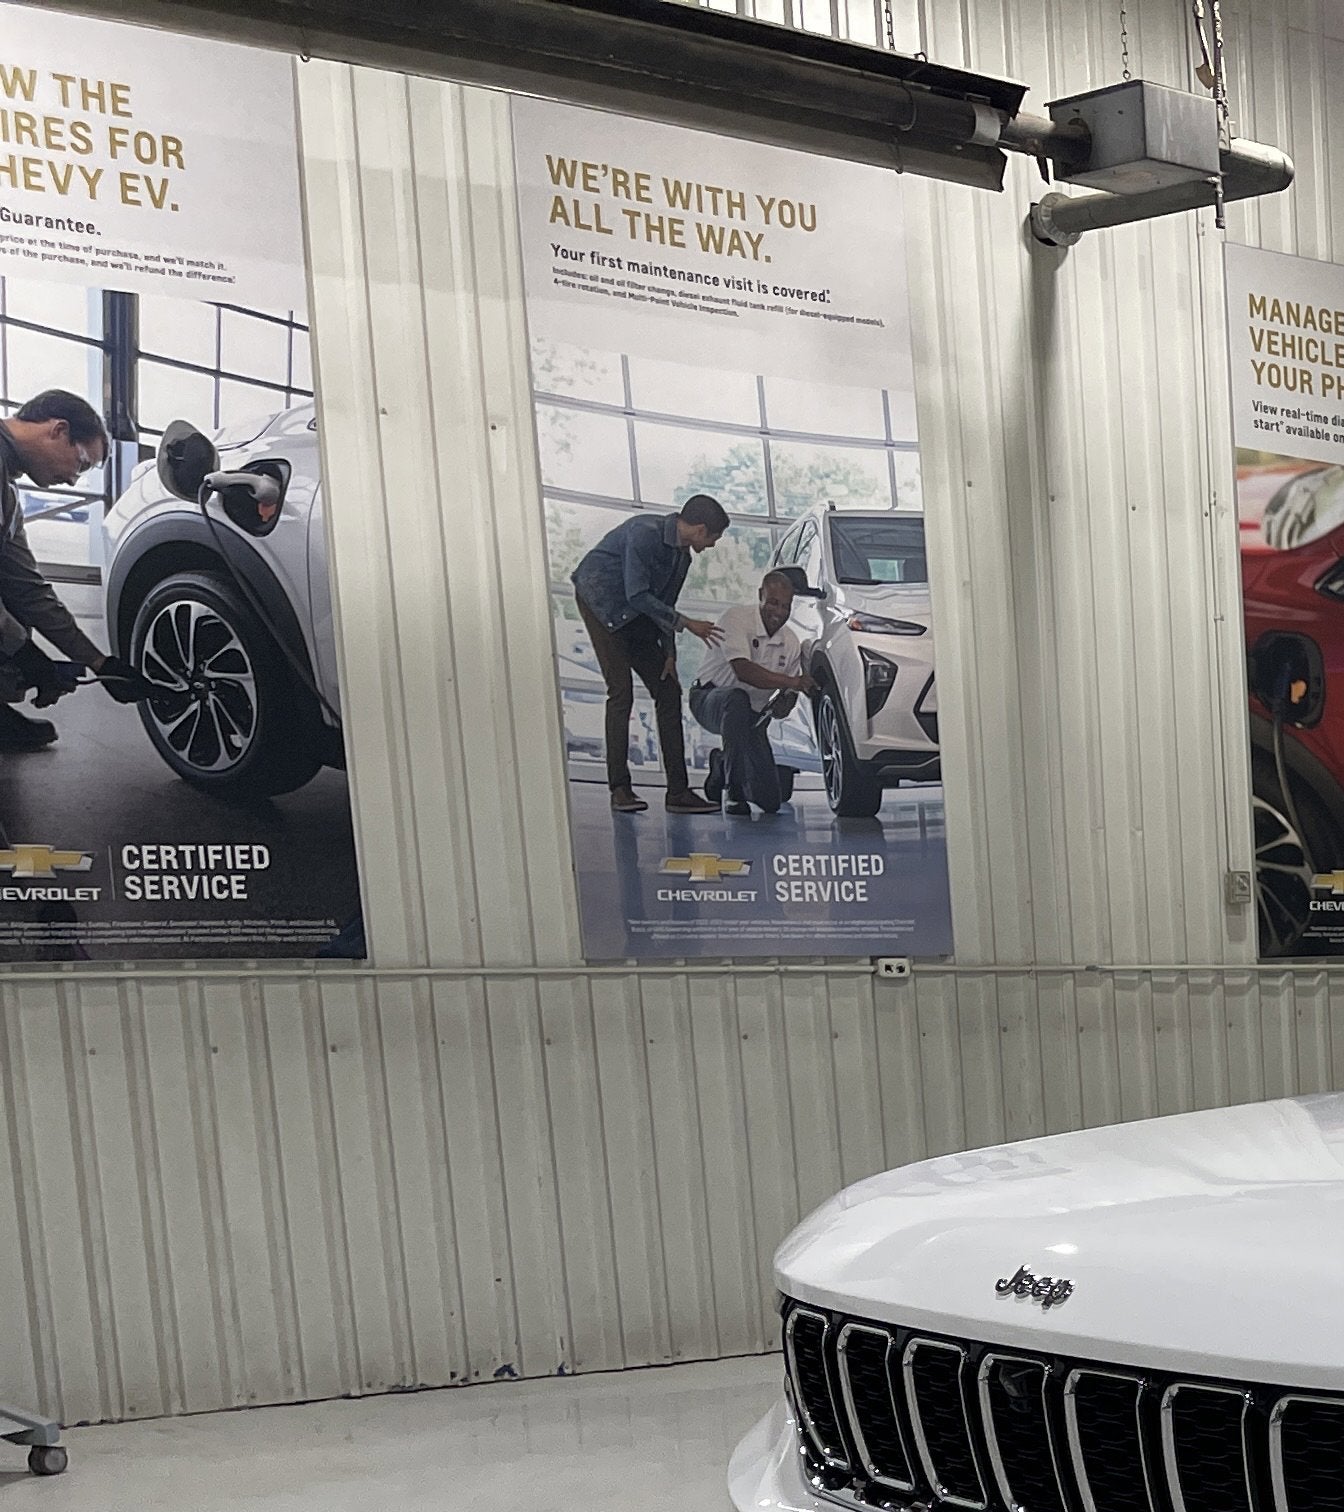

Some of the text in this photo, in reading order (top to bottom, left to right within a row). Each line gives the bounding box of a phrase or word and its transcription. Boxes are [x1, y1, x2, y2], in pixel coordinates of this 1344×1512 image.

[51, 72, 133, 118] THE
[0, 109, 186, 170] IRES FOR
[0, 154, 180, 212] HEVY EV.
[545, 154, 817, 233] WE'RE WITH YOU
[0, 207, 102, 236] Guarantee.
[549, 195, 773, 263] ALL THE WAY.
[550, 242, 585, 262] Your
[590, 250, 623, 270] first
[627, 260, 720, 287] maintenance
[722, 275, 753, 293] visit
[757, 279, 768, 294] is
[1250, 359, 1313, 395] YOUR
[1252, 399, 1278, 416] View
[1280, 407, 1329, 425] real-time
[1285, 425, 1331, 441] available
[121, 844, 272, 870] CERTIFIED
[773, 854, 884, 877] CERTIFIED
[0, 887, 102, 901] EVROLET
[124, 875, 248, 900] SERVICE
[657, 889, 758, 902] CHEVROLET
[775, 881, 869, 902] SERVICE
[995, 1263, 1075, 1310] Jeep
